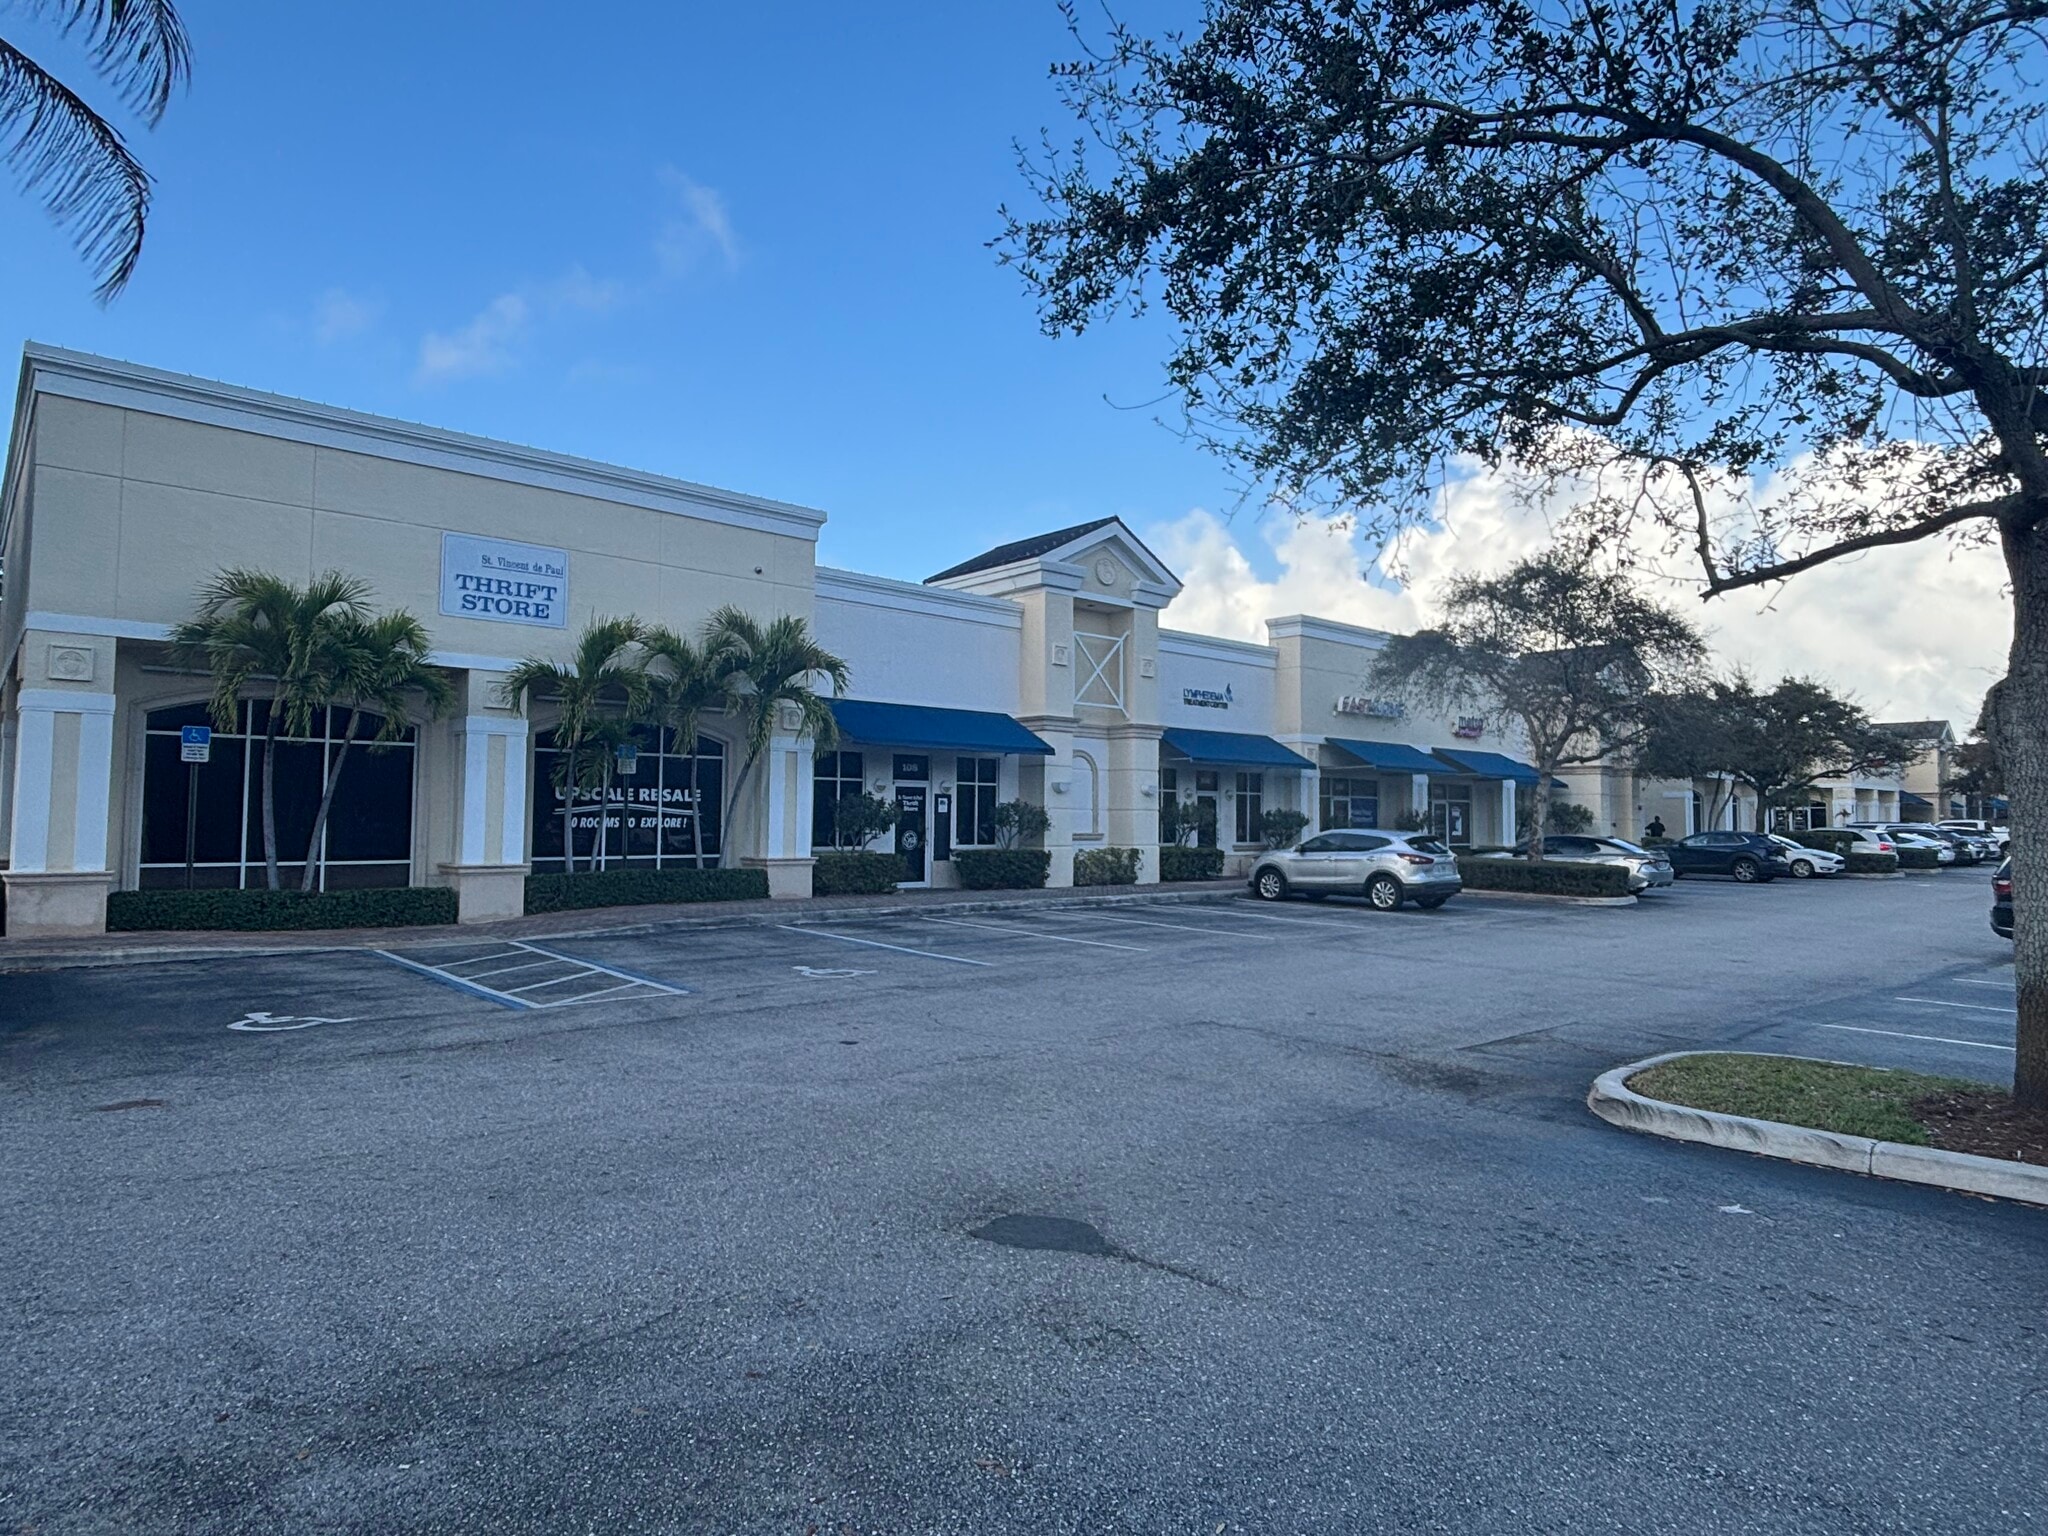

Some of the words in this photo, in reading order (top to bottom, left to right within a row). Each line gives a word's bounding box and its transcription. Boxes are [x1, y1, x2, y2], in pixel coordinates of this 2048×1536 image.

[481, 554, 493, 565] St.
[497, 556, 529, 571] Vincent
[532, 562, 543, 573] de
[545, 563, 564, 576] Paul
[455, 573, 558, 602] THRIFT
[461, 593, 550, 619] STORE
[639, 788, 702, 802] RESALE
